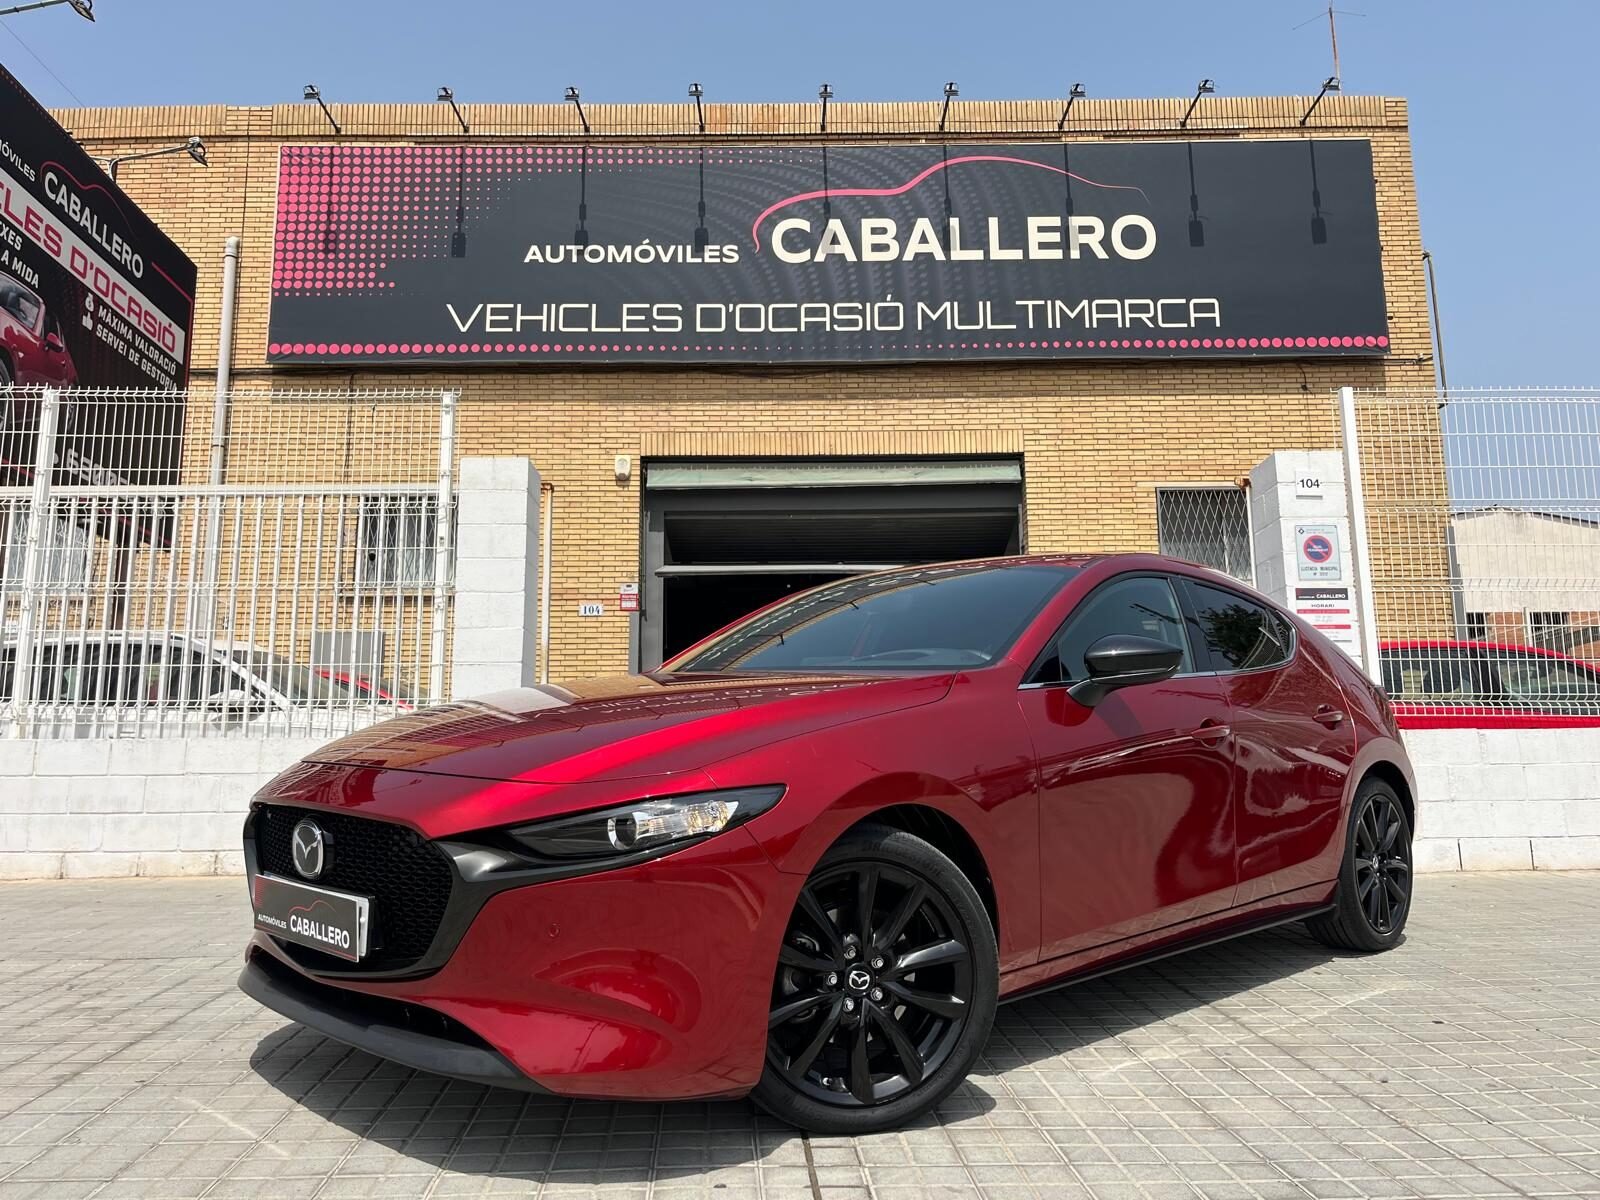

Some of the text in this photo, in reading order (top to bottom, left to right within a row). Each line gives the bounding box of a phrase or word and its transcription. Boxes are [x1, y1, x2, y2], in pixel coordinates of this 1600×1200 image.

[0, 139, 144, 279] ÓVILES CABALLERO
[524, 214, 1157, 264] AUTOMÓVILES CABALLERO
[0, 181, 176, 353] LES D'OCASIÓ
[1, 249, 39, 288] A MIDA
[446, 294, 1221, 333] VEHICLES D'OCASIÓ MULTIMARCA
[96, 324, 127, 356] SERVEI
[128, 349, 141, 366] DE
[135, 334, 176, 376] VALORACIÓ
[1299, 478, 1320, 488] 104
[584, 605, 600, 615] 104
[257, 913, 350, 949] AUTOMÓVILES CABALLERO
